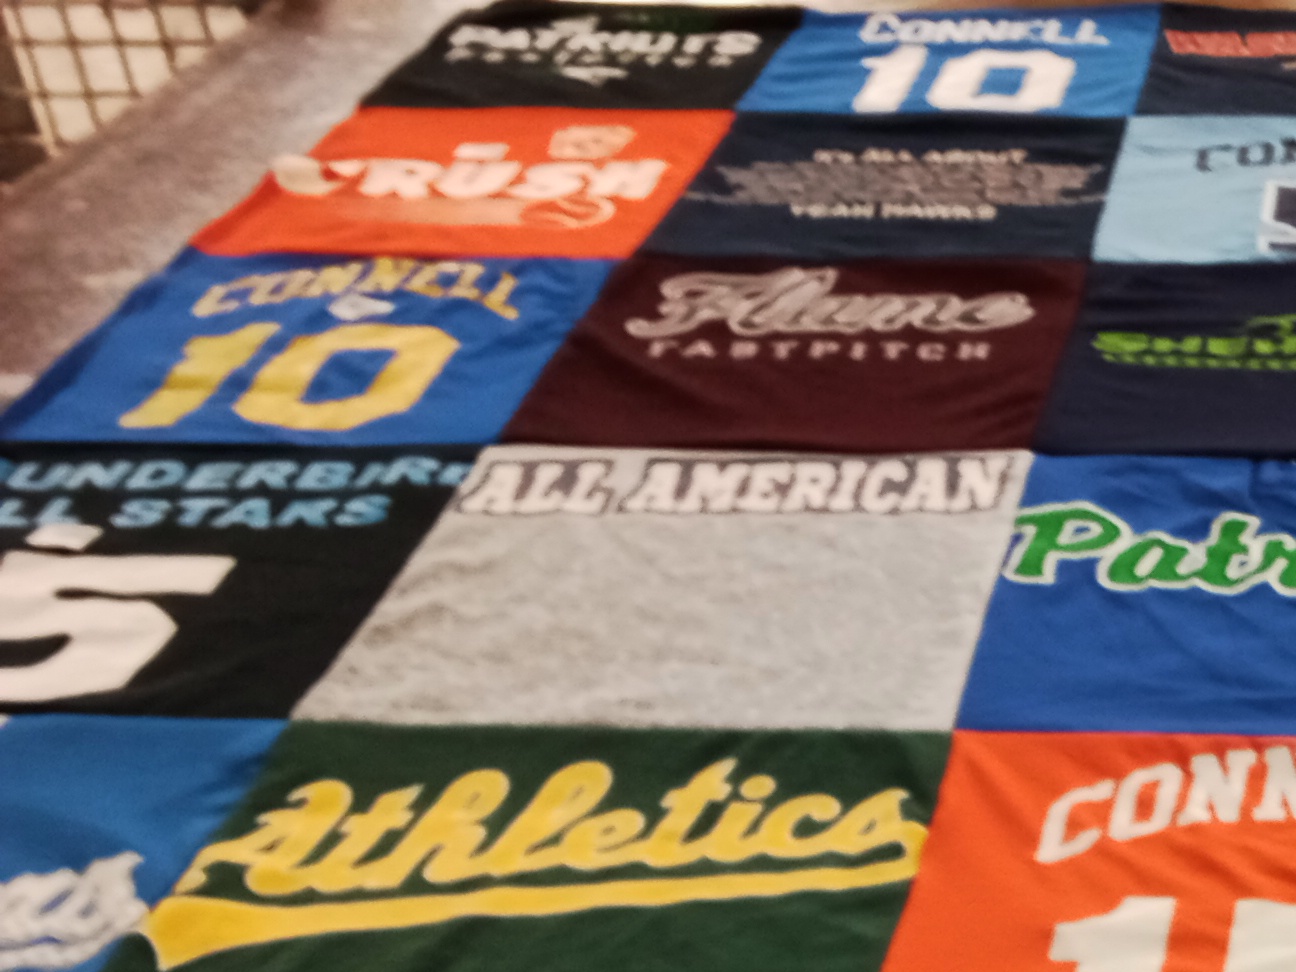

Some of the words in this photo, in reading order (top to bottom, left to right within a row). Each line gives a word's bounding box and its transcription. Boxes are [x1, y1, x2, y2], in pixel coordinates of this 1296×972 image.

[851, 43, 1076, 113] 10
[192, 257, 519, 320] CONNELL
[117, 321, 461, 431] 10
[110, 494, 393, 528] STARS
[456, 459, 613, 516] ALL
[616, 456, 1012, 516] AMERICAN
[0, 550, 237, 702] 5
[170, 758, 928, 898] Athletics
